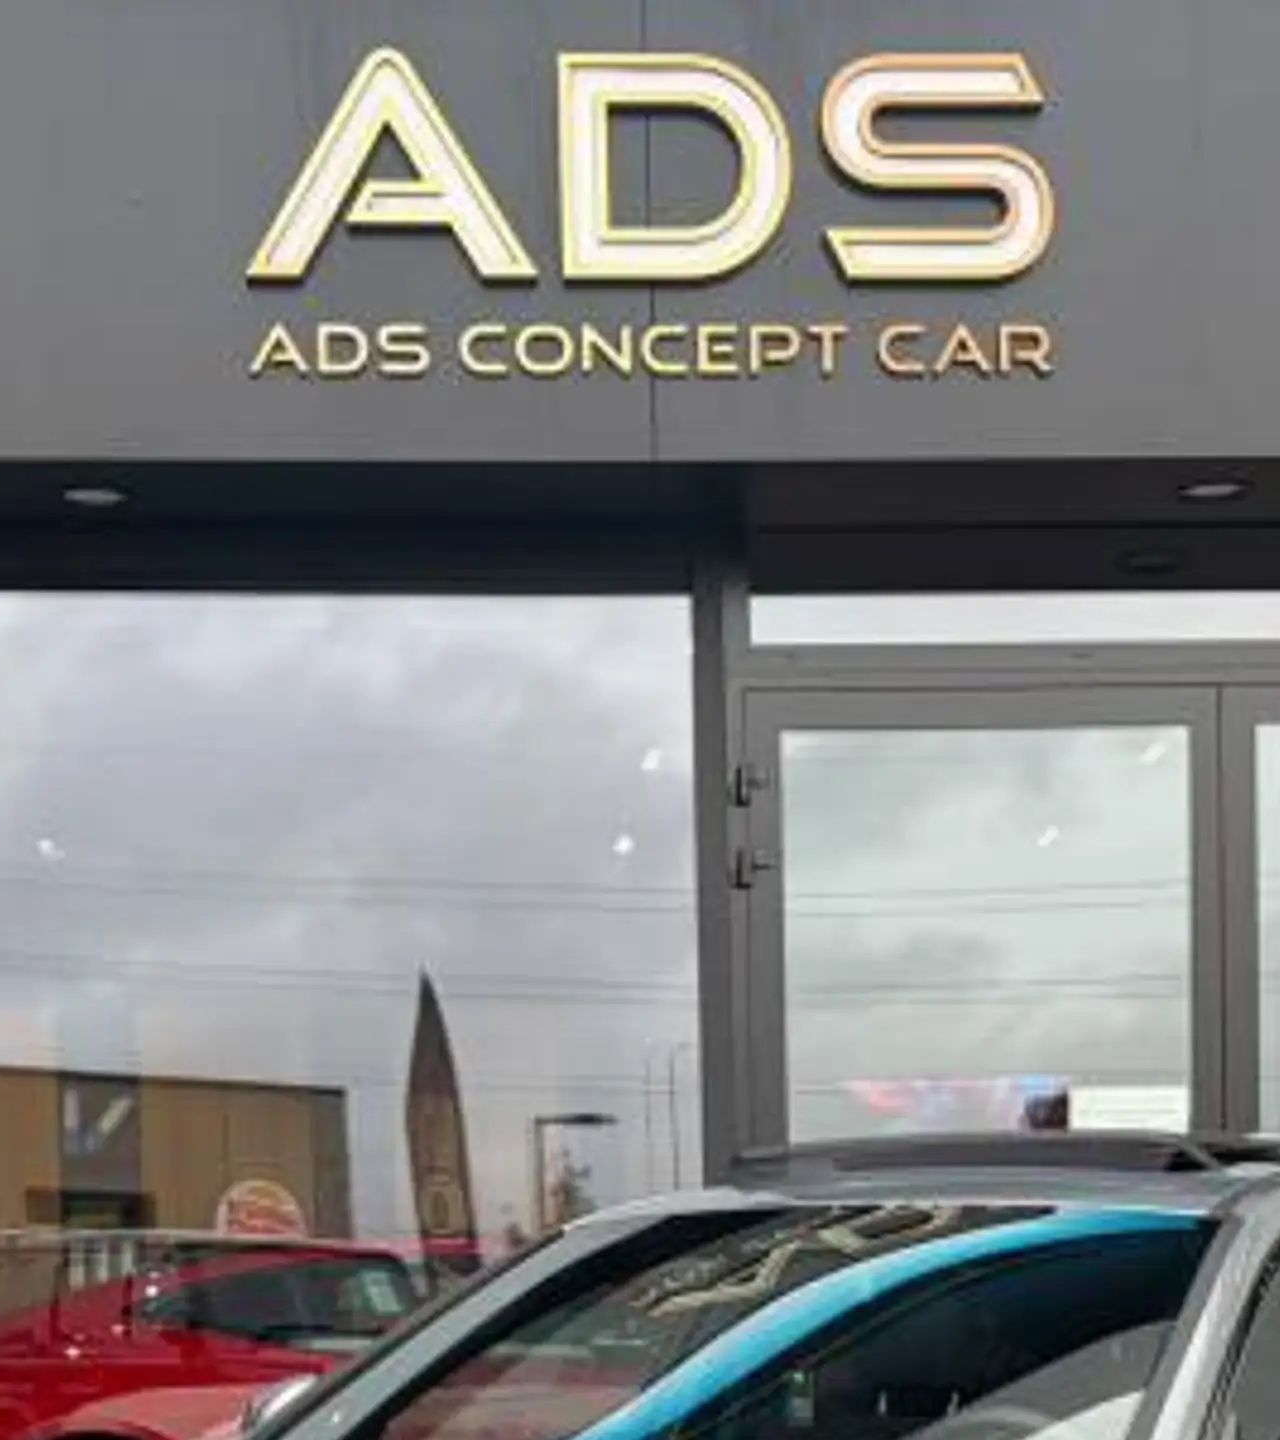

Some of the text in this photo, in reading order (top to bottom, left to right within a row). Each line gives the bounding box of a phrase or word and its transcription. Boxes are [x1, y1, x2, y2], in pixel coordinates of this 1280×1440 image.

[246, 46, 1056, 282] ADS
[249, 321, 1054, 376] ADS CONCEPT CAR
